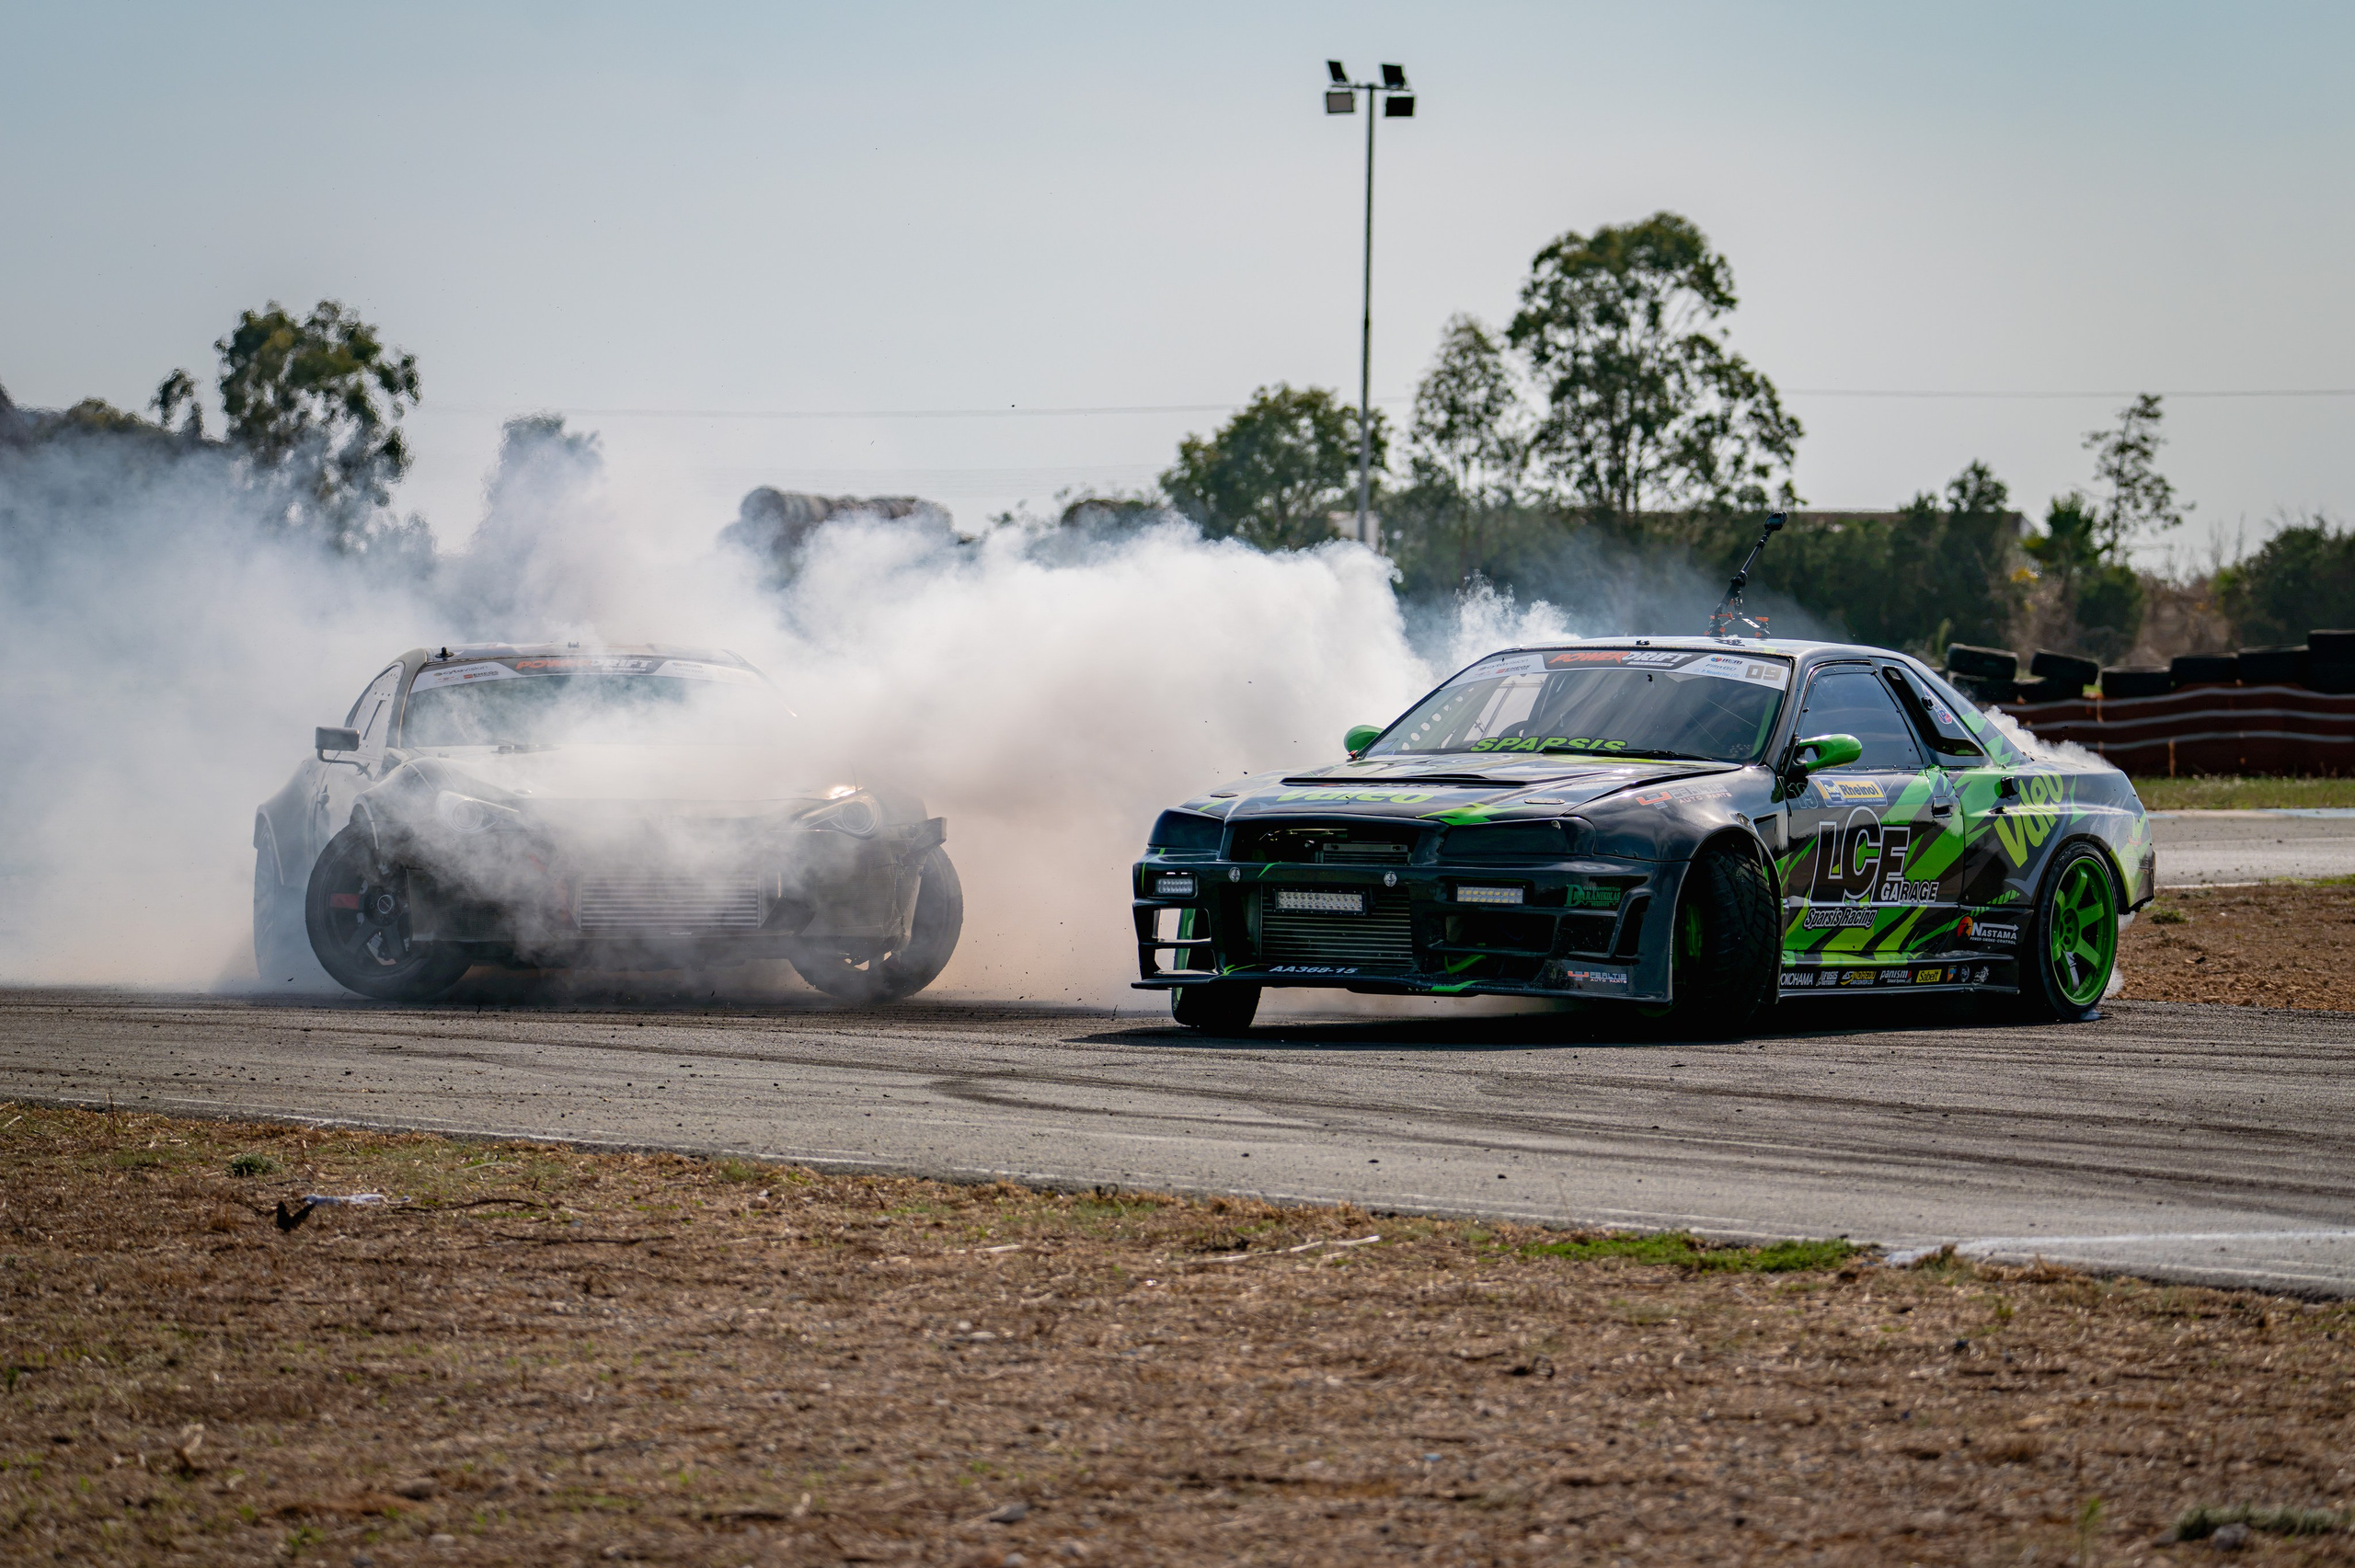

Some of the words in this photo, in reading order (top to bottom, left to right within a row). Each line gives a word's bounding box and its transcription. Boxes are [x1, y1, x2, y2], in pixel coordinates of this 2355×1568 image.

[1745, 664, 1783, 681] 09
[1471, 737, 1626, 751] SPARSIS
[1840, 784, 1879, 796] Rheinol
[1880, 880, 1940, 903] GARAGE
[1803, 908, 1841, 930] Sparsis
[1840, 907, 1878, 929] Racing
[1970, 921, 2017, 940] NASTAMA
